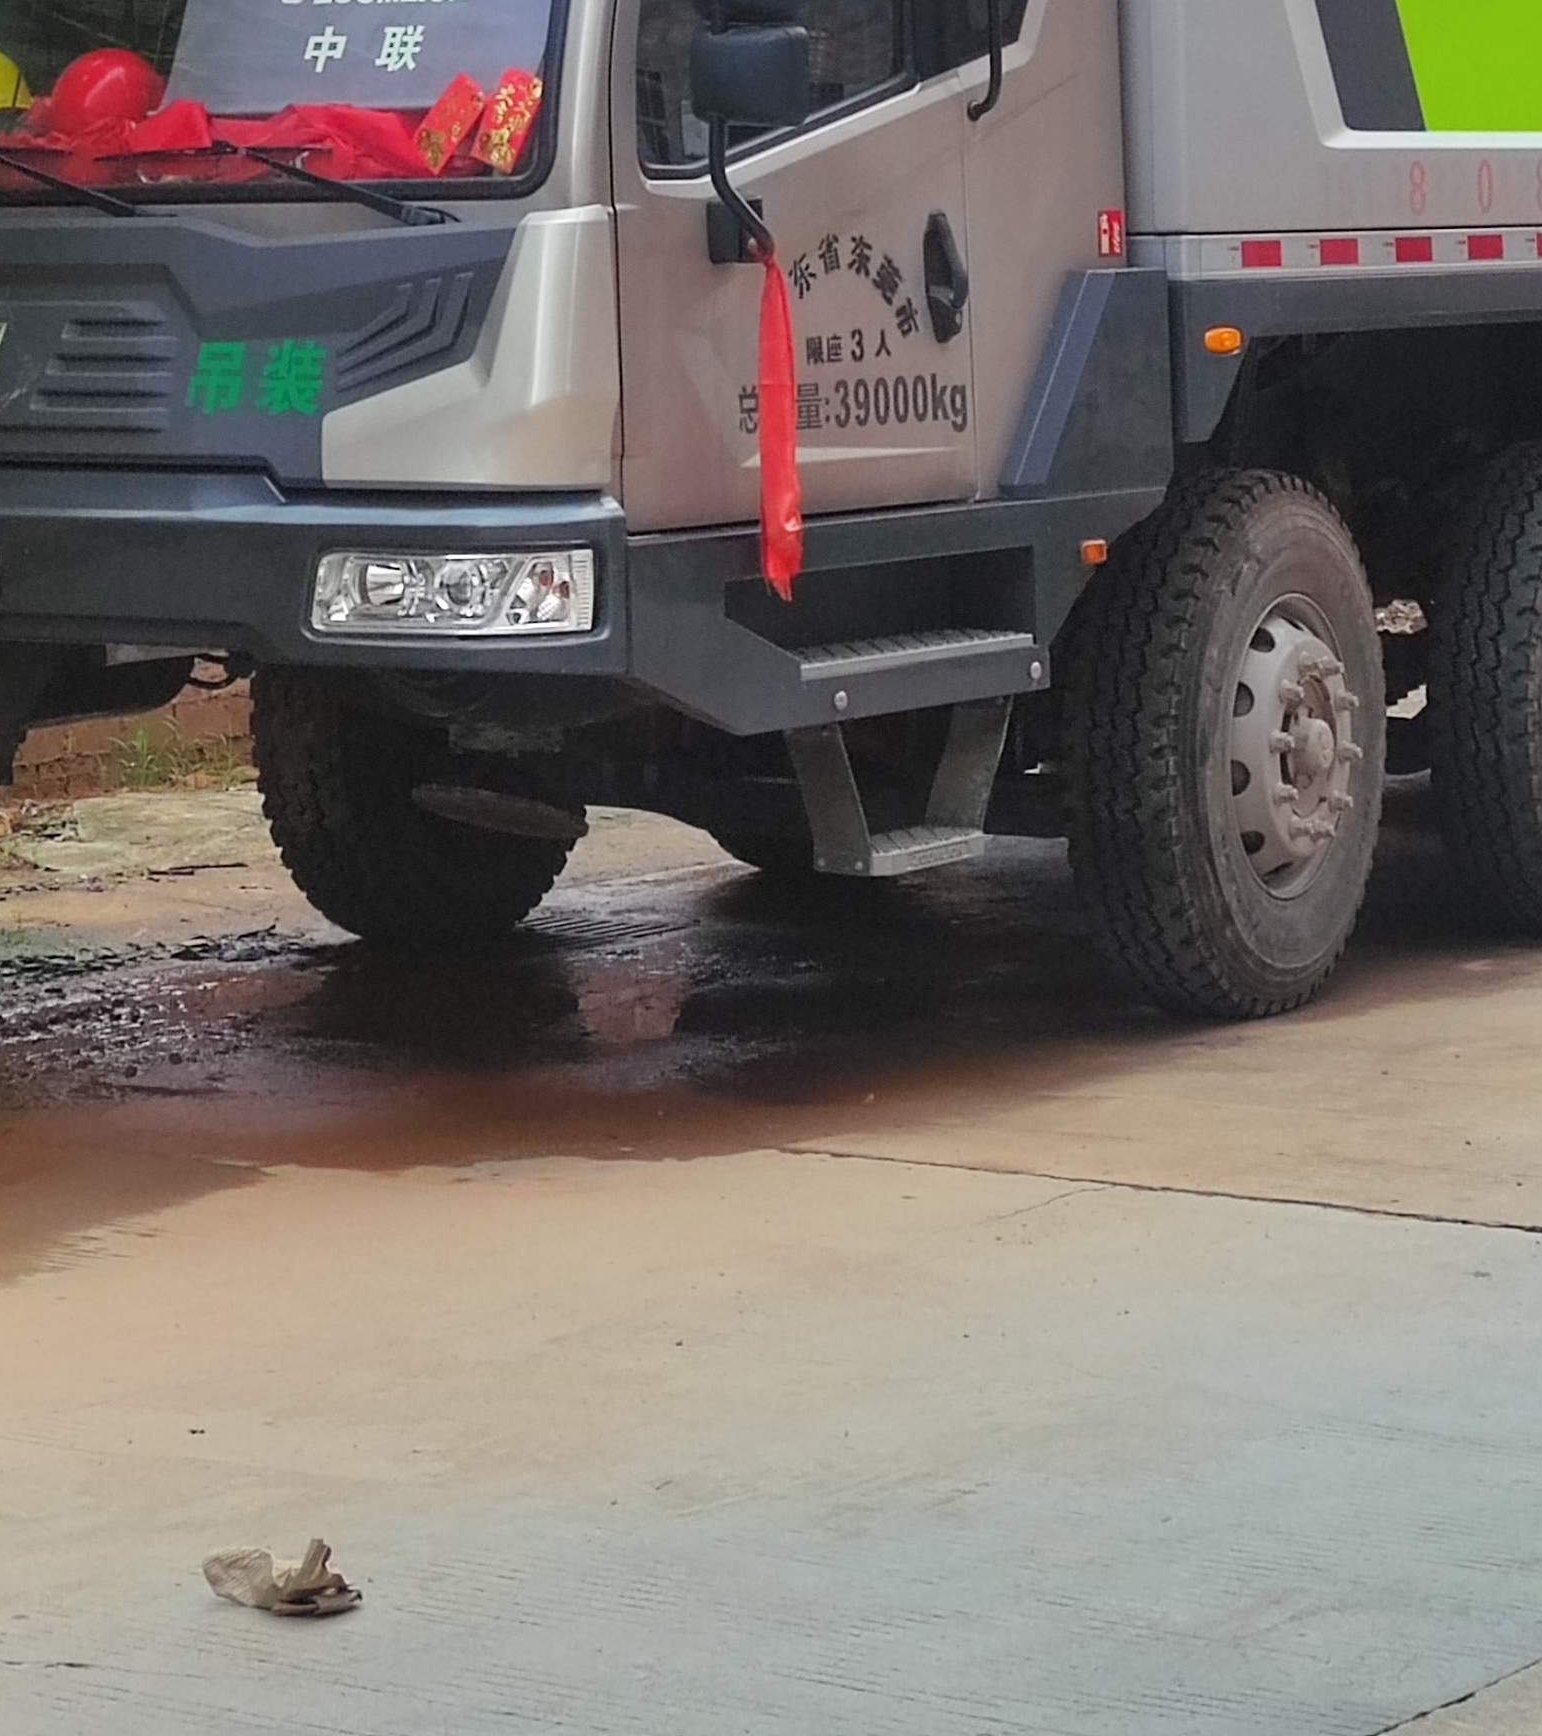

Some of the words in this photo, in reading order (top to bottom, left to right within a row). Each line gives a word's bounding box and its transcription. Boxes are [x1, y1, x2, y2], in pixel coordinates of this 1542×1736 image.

[788, 233, 919, 339] 东省东莞市
[185, 337, 328, 417] 吊装
[738, 373, 968, 433] 总量:39000kg
